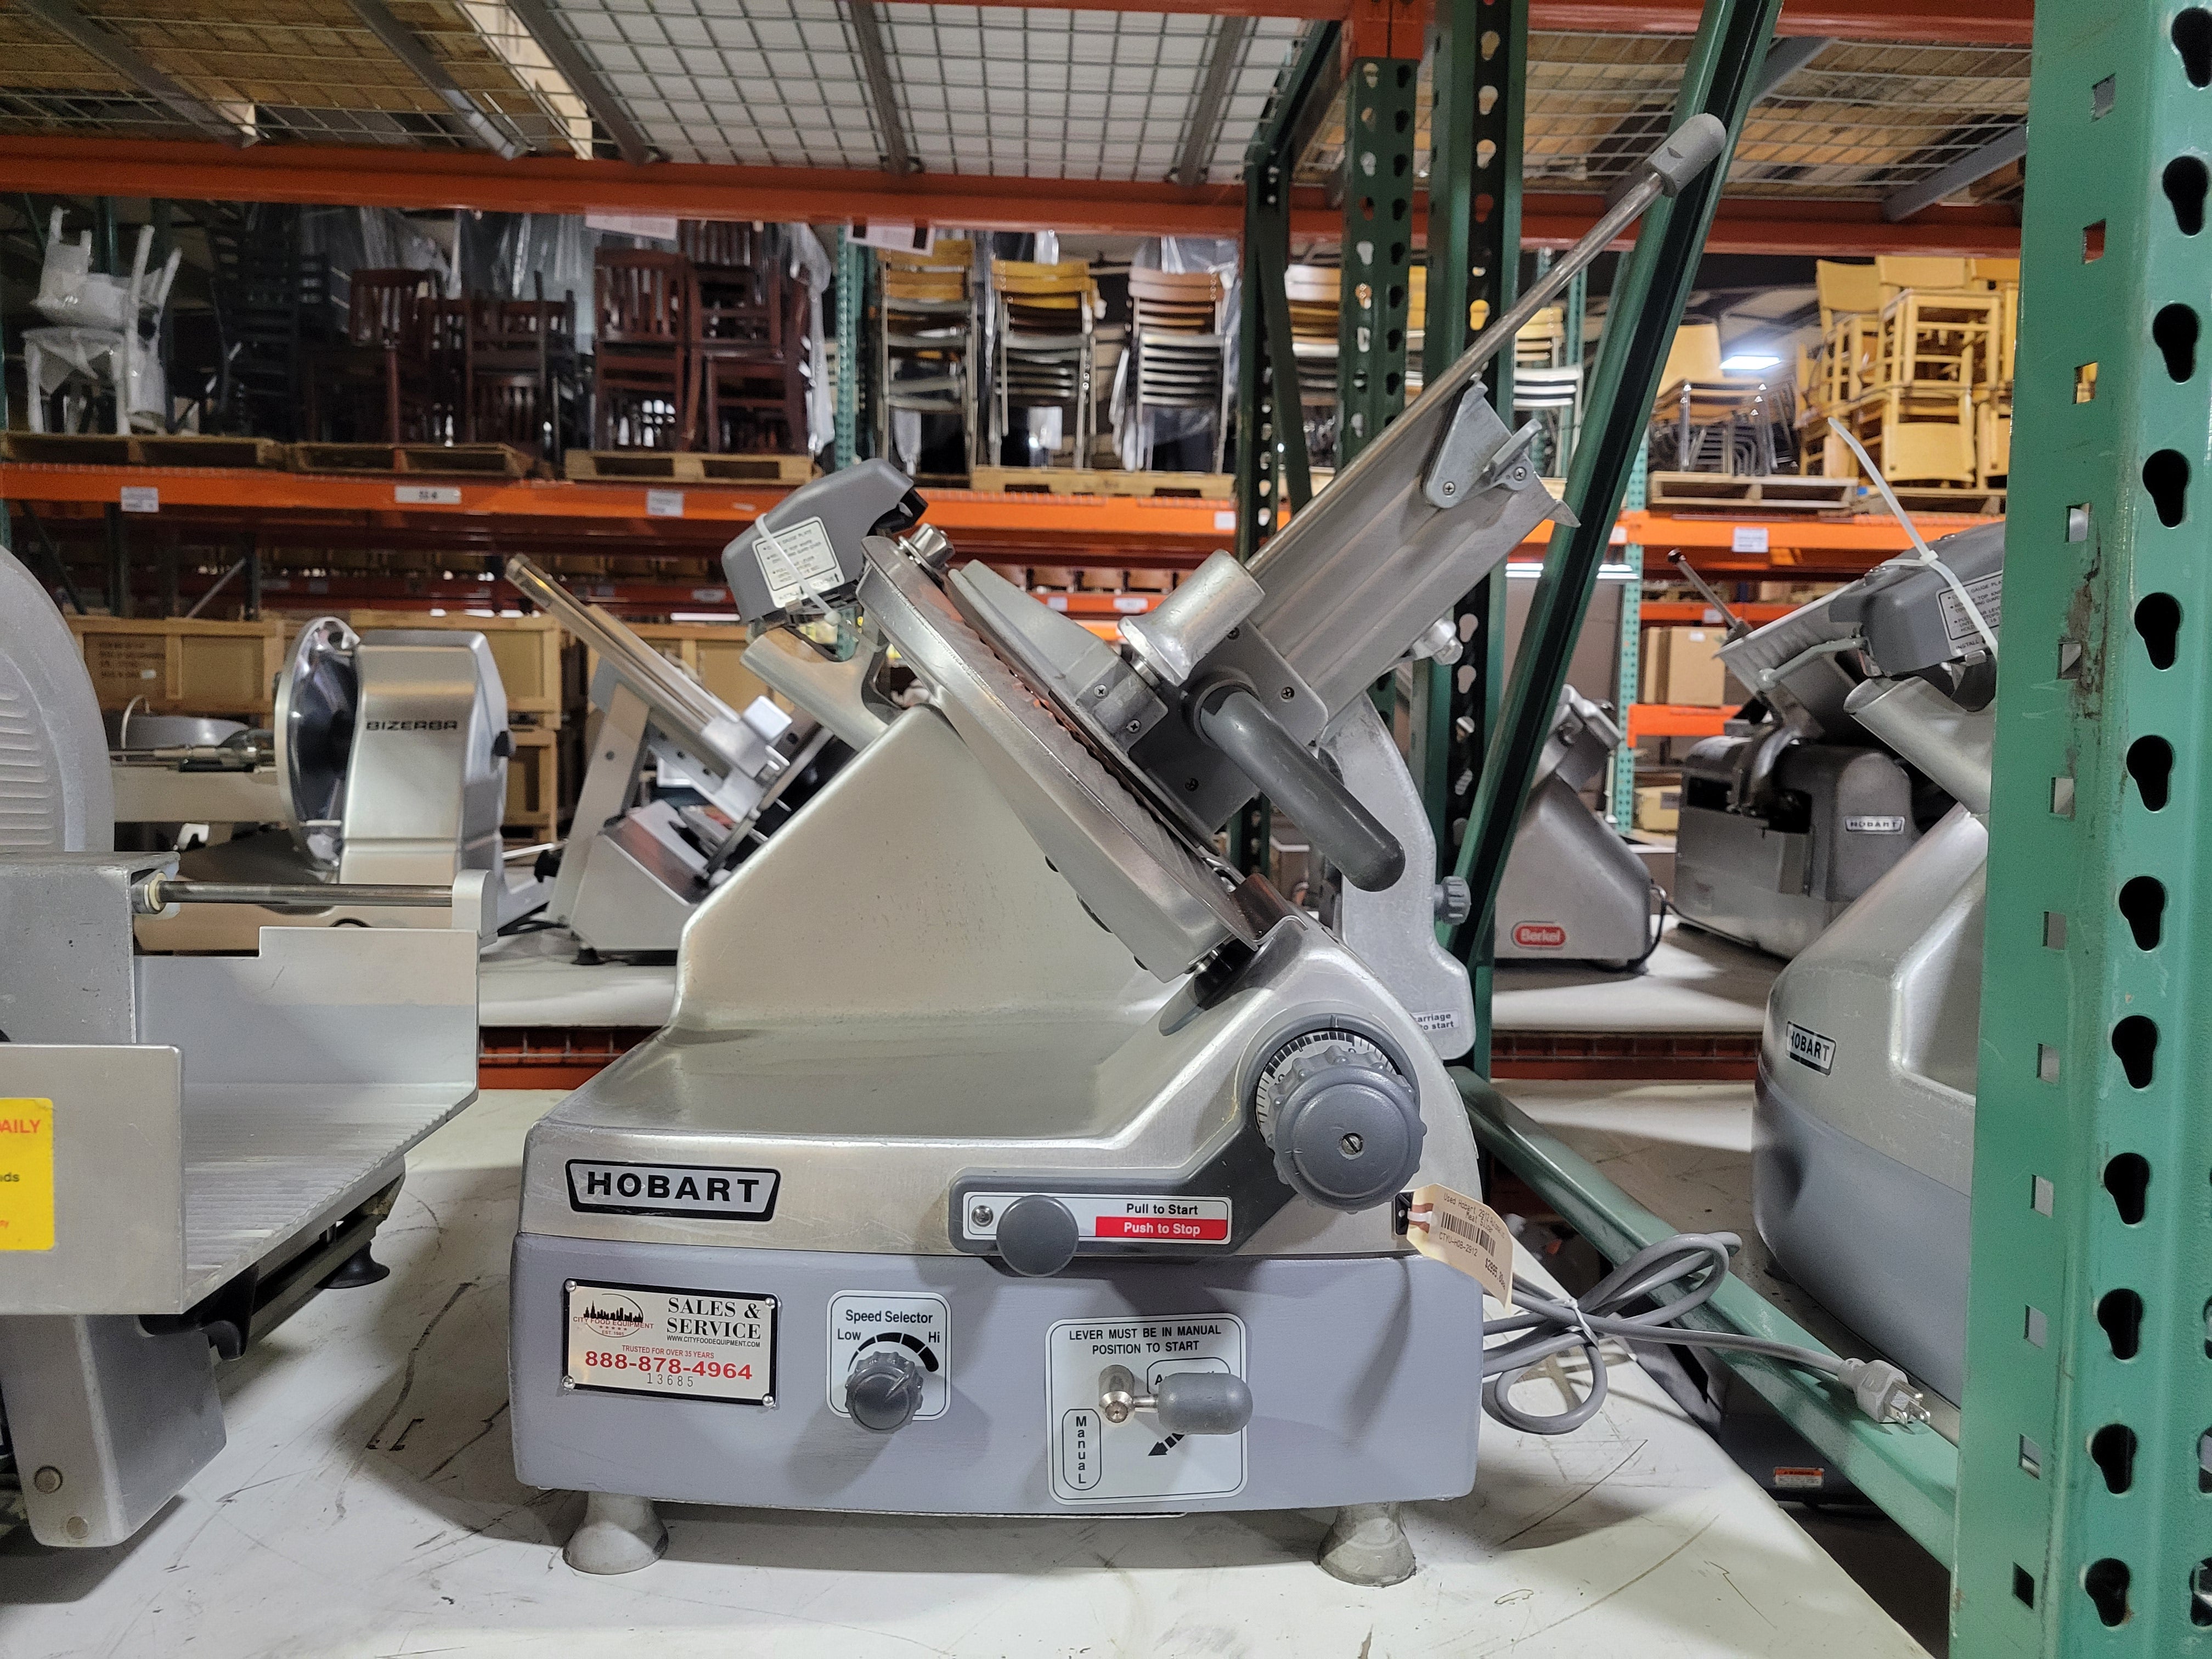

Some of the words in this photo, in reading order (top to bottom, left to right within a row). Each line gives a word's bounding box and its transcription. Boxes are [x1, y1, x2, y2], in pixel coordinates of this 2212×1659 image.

[1956, 639, 1979, 650] INSTALL
[366, 720, 458, 731] BIZERBA
[1521, 928, 1560, 943] Berkel
[1414, 1013, 1452, 1023] arriage
[1432, 1020, 1454, 1030] start
[0, 1119, 41, 1134] AILY
[586, 1171, 760, 1203] HOBART
[1126, 1203, 1149, 1214] Pull
[1153, 1204, 1165, 1214] to
[1168, 1204, 1199, 1215] Start
[1443, 1192, 1457, 1205] Used
[1458, 1199, 1476, 1215] Hobart
[1478, 1209, 1490, 1222] 2912
[1465, 1211, 1477, 1224] Meat
[1124, 1221, 1154, 1234] Push
[1157, 1222, 1170, 1234] to
[1172, 1223, 1201, 1237] Stop
[668, 1296, 736, 1318] SALES
[743, 1302, 761, 1319] &
[590, 1317, 611, 1325] FOOD
[612, 1319, 654, 1329] EQUIPMENT
[845, 1308, 882, 1324] Speed
[884, 1310, 934, 1324] Selector
[667, 1317, 761, 1340] SERVICE
[837, 1328, 862, 1341] Low
[1069, 1329, 1104, 1341] LEVER
[1108, 1328, 1138, 1340] MUST
[1142, 1327, 1158, 1338] BE
[1162, 1326, 1172, 1337] IN
[1177, 1324, 1222, 1337] MANUAL
[667, 1334, 760, 1348] WWW.CITYFOODEQUIPMENT.COM
[928, 1331, 941, 1344] Hi
[622, 1345, 650, 1353] TRUSTED
[652, 1347, 664, 1355] FOR
[665, 1348, 684, 1357] OVER
[1092, 1343, 1142, 1355] POSITION
[1146, 1342, 1161, 1353] TO
[1165, 1340, 1200, 1352] START
[585, 1350, 753, 1380] 888-878-4964
[647, 1372, 694, 1387] 13685
